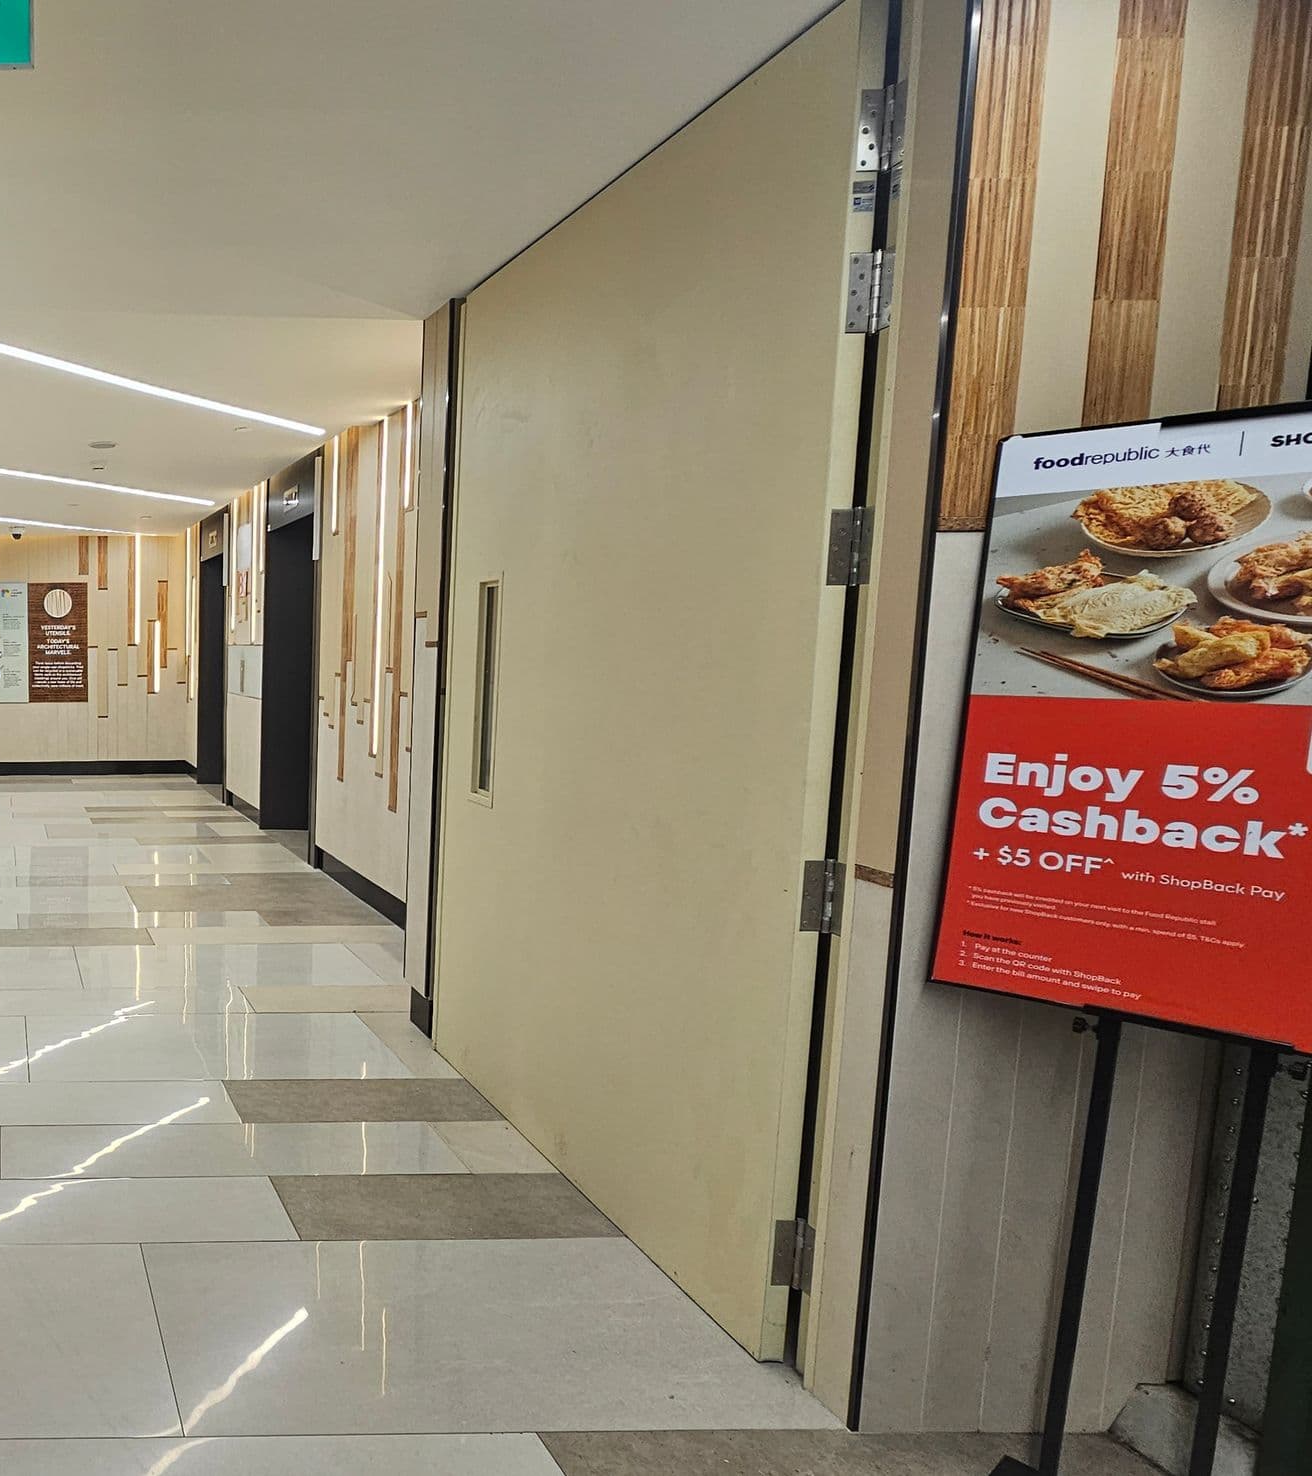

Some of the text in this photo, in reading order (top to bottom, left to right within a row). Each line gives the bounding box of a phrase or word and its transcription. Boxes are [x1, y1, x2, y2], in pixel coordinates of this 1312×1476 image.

[1165, 443, 1211, 458] 大食代
[984, 752, 1259, 804] Enjoy 5%
[973, 847, 990, 860] +
[997, 845, 1031, 867] $5
[1121, 871, 1156, 883] with
[1159, 874, 1245, 895] ShopBack
[1251, 885, 1286, 901] Pay
[1024, 909, 1058, 919] ShopBack
[962, 929, 983, 939] How
[974, 942, 991, 954] Pay
[1001, 948, 1017, 956] the
[1017, 951, 1053, 963] counter
[972, 961, 996, 973] Enter
[996, 967, 1011, 975] the
[1011, 970, 1026, 978] bill
[1026, 974, 1061, 985] amount
[1062, 979, 1081, 989] and
[1081, 982, 1110, 993] swipe
[1111, 988, 1122, 996] to
[1122, 991, 1142, 1001] pay
[973, 952, 995, 963] Scan
[996, 957, 1011, 965] the
[1012, 959, 1026, 968] QR
[1027, 962, 1051, 972] code
[1051, 968, 1073, 977] with
[1073, 970, 1122, 985] ShopBack
